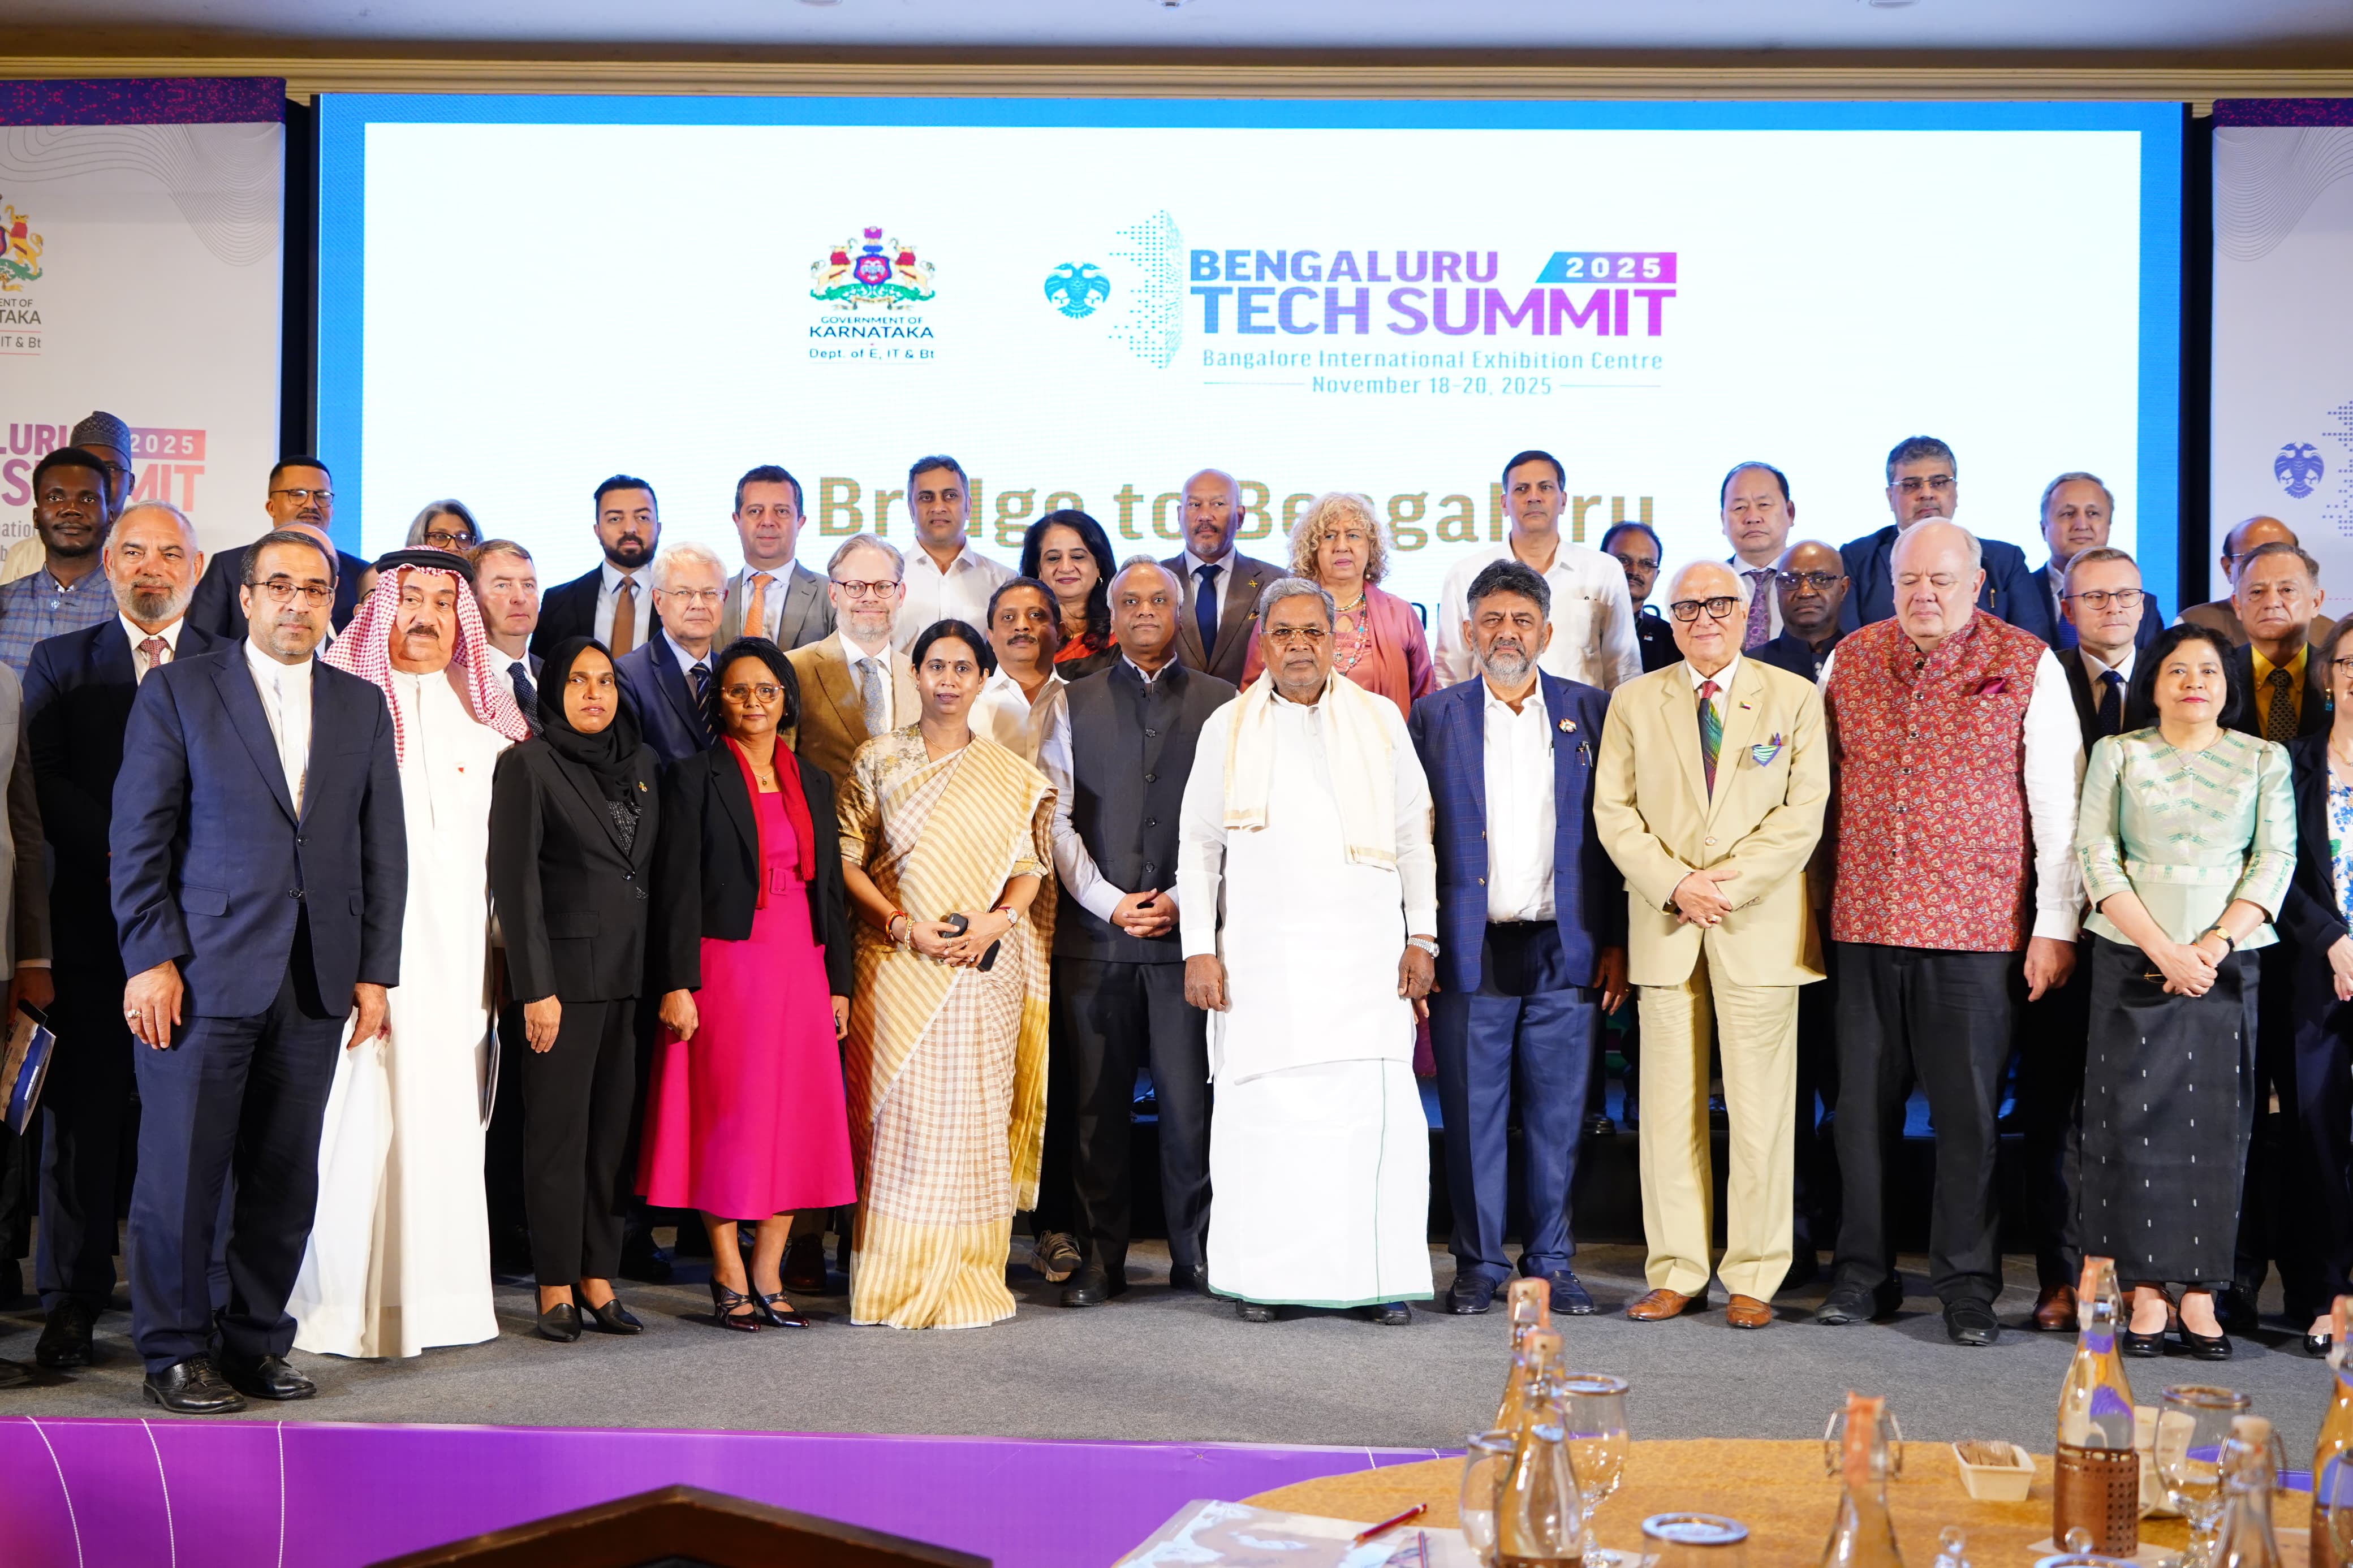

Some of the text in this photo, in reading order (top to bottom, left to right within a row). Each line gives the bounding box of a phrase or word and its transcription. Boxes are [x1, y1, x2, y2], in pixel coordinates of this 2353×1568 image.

[1190, 249, 1661, 283] BENGALURU 2025
[19, 299, 33, 308] OF
[1190, 286, 1677, 336] TECH SUMMIT
[1, 336, 41, 348] IT & Bt
[809, 326, 934, 339] KARNATAKA
[851, 349, 864, 358] of
[870, 348, 882, 360] E,
[887, 349, 900, 358] IT
[905, 349, 914, 359] &
[920, 349, 934, 359] Bt
[1203, 349, 1662, 369] Bangalore International Exhibition Centre
[1313, 376, 1551, 395] November 18-20, 2025
[131, 434, 193, 454] 2025
